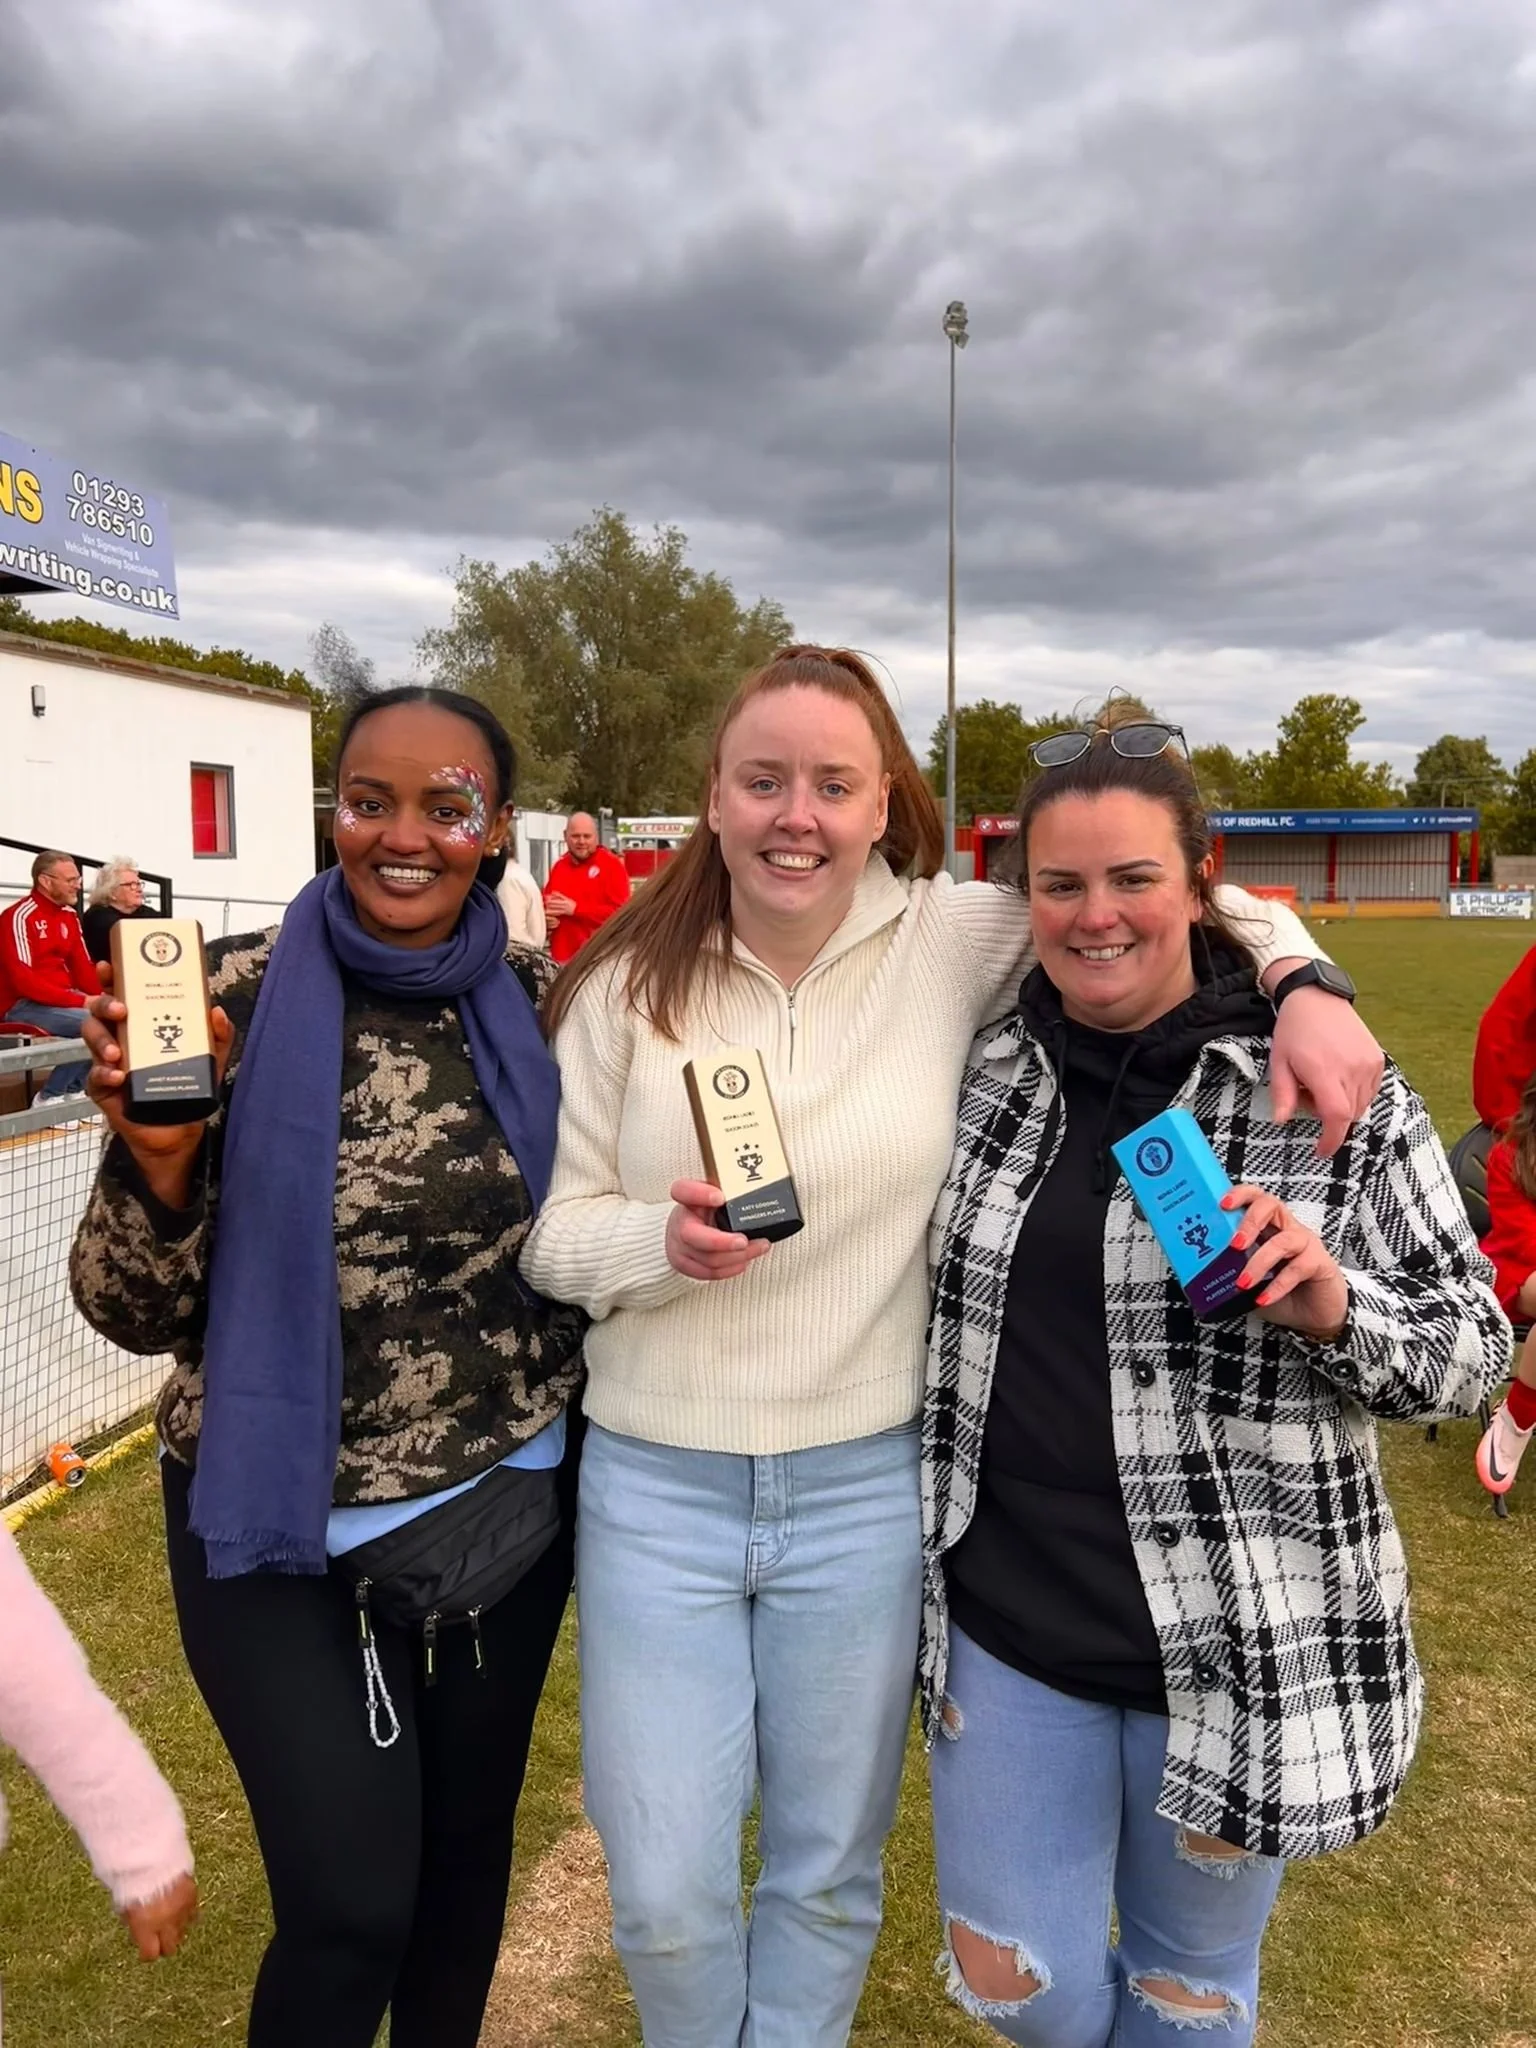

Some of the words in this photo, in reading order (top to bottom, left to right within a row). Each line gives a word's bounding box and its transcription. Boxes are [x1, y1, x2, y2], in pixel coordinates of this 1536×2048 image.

[72, 470, 145, 518] 01293
[66, 494, 154, 546] 786510
[1223, 817, 1236, 827] OF
[1238, 816, 1278, 828] REDHILL
[1469, 894, 1524, 906] PHILLIPS
